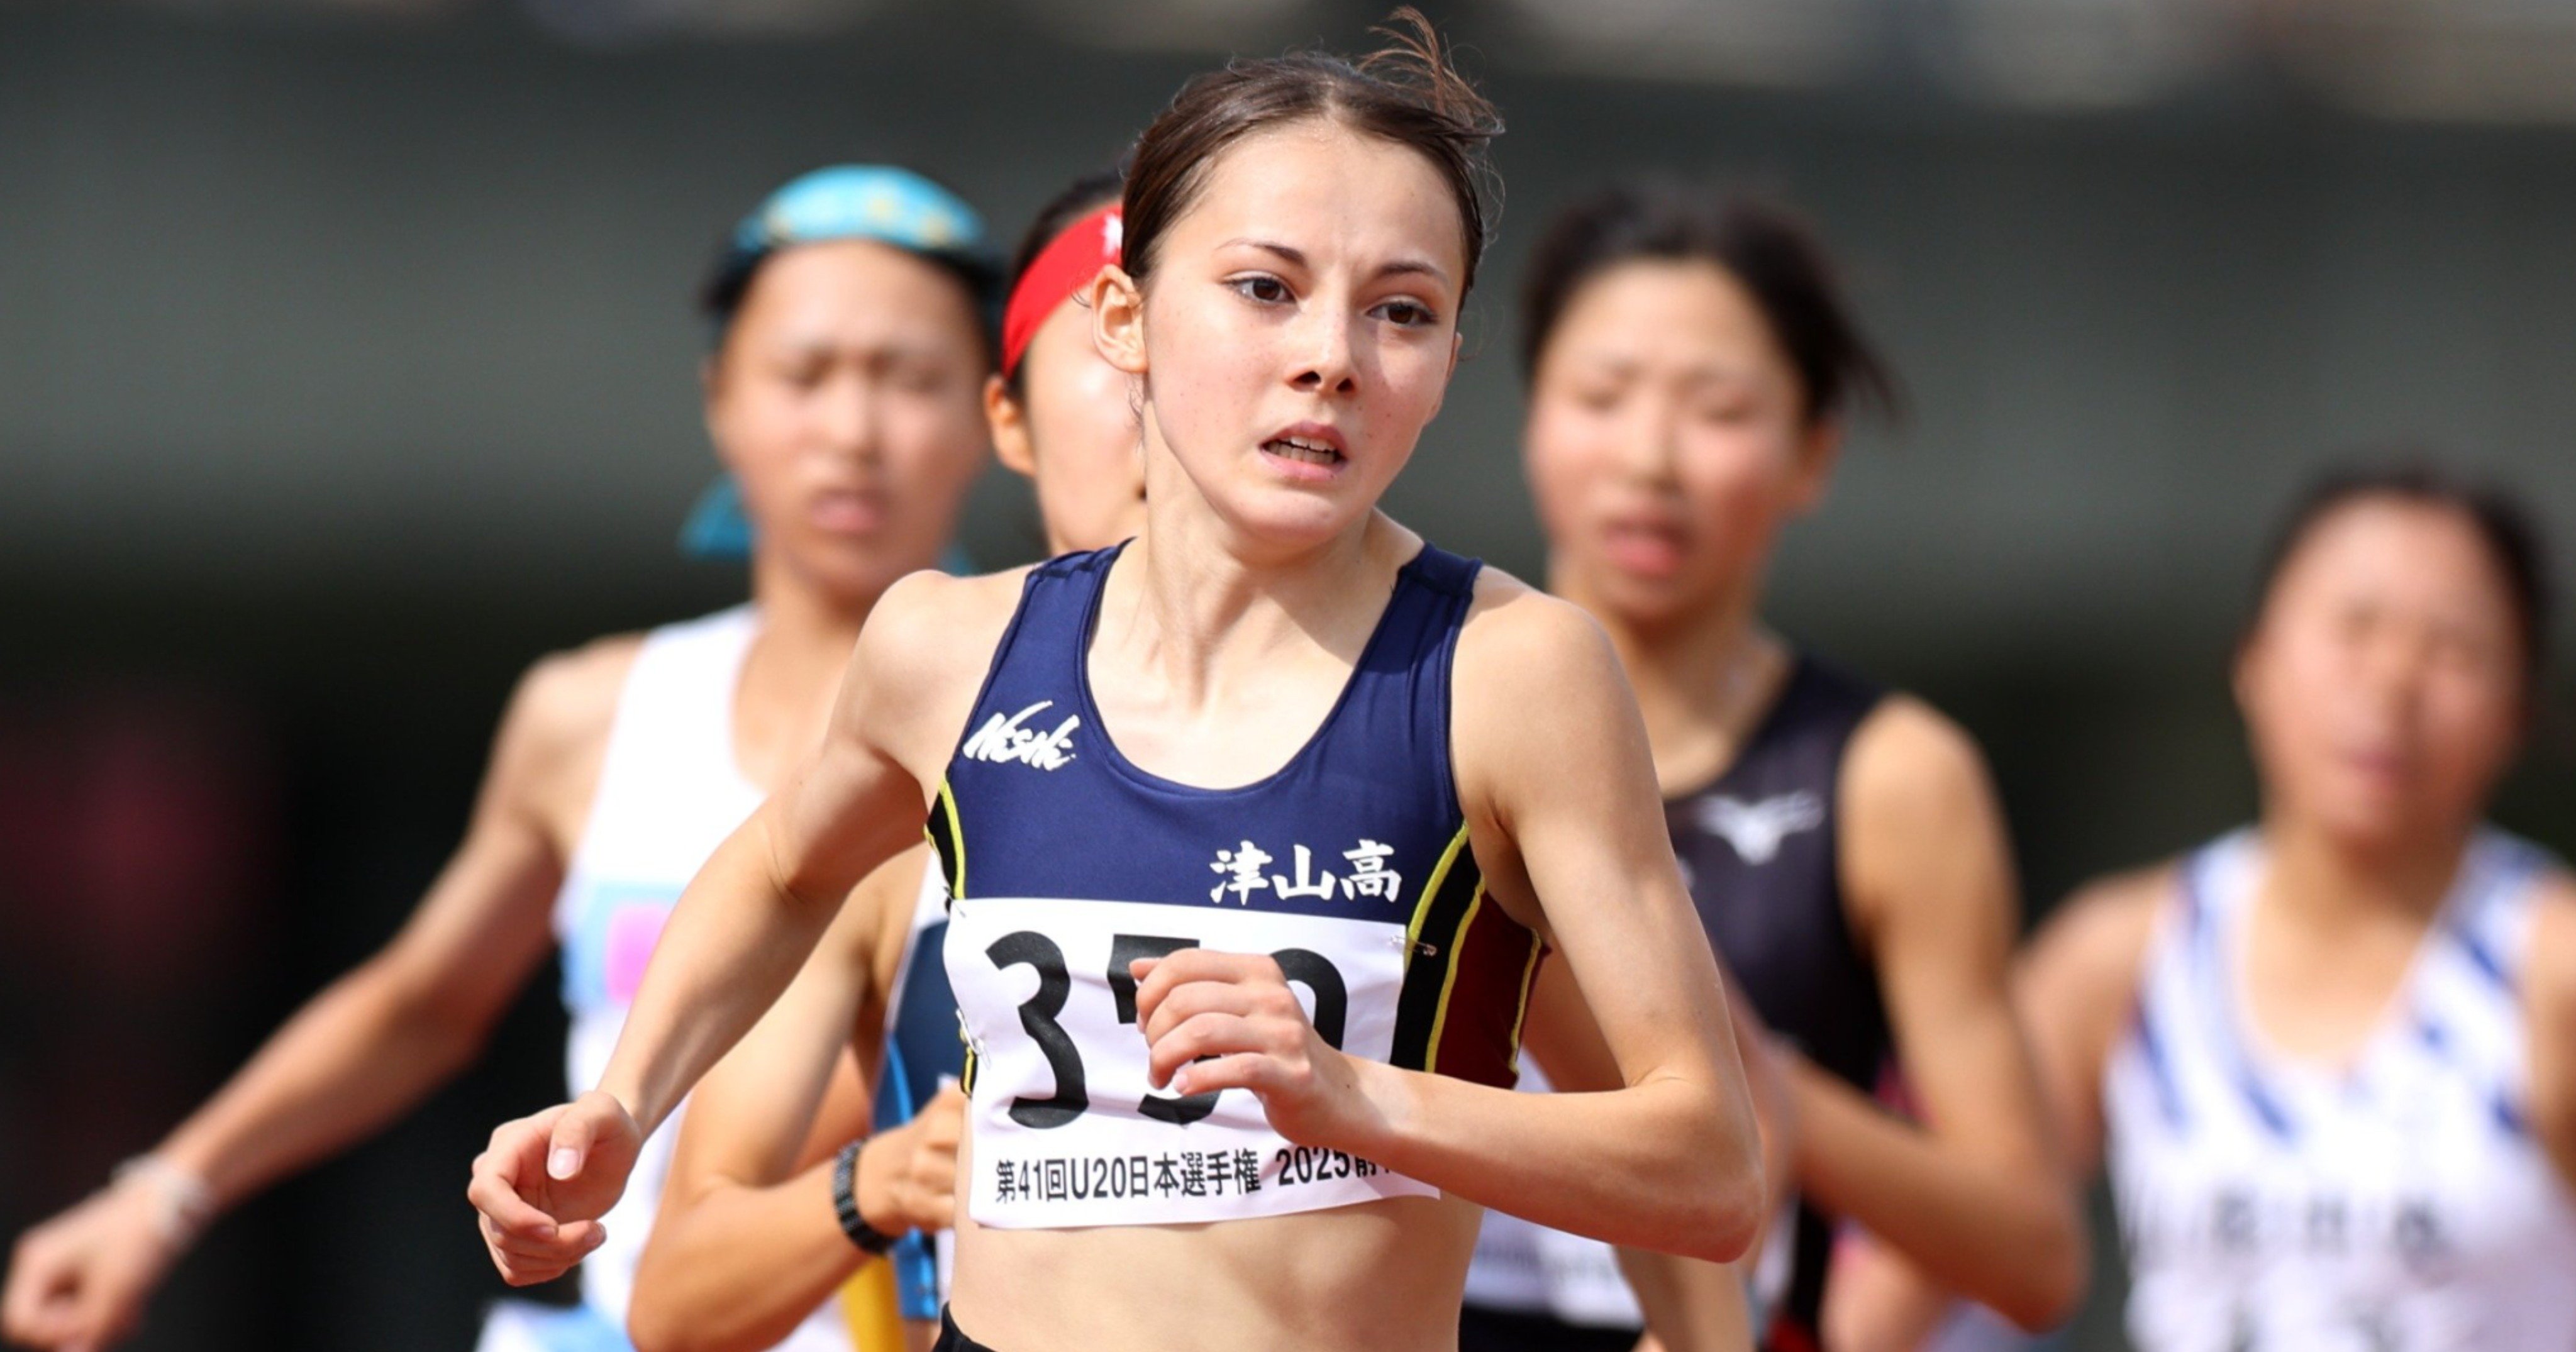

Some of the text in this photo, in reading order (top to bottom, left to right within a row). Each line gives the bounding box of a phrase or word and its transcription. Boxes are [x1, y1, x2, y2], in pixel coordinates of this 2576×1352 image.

[1209, 838, 1402, 906] 津山高
[996, 1148, 1262, 1204] 第41回U20日本選手権
